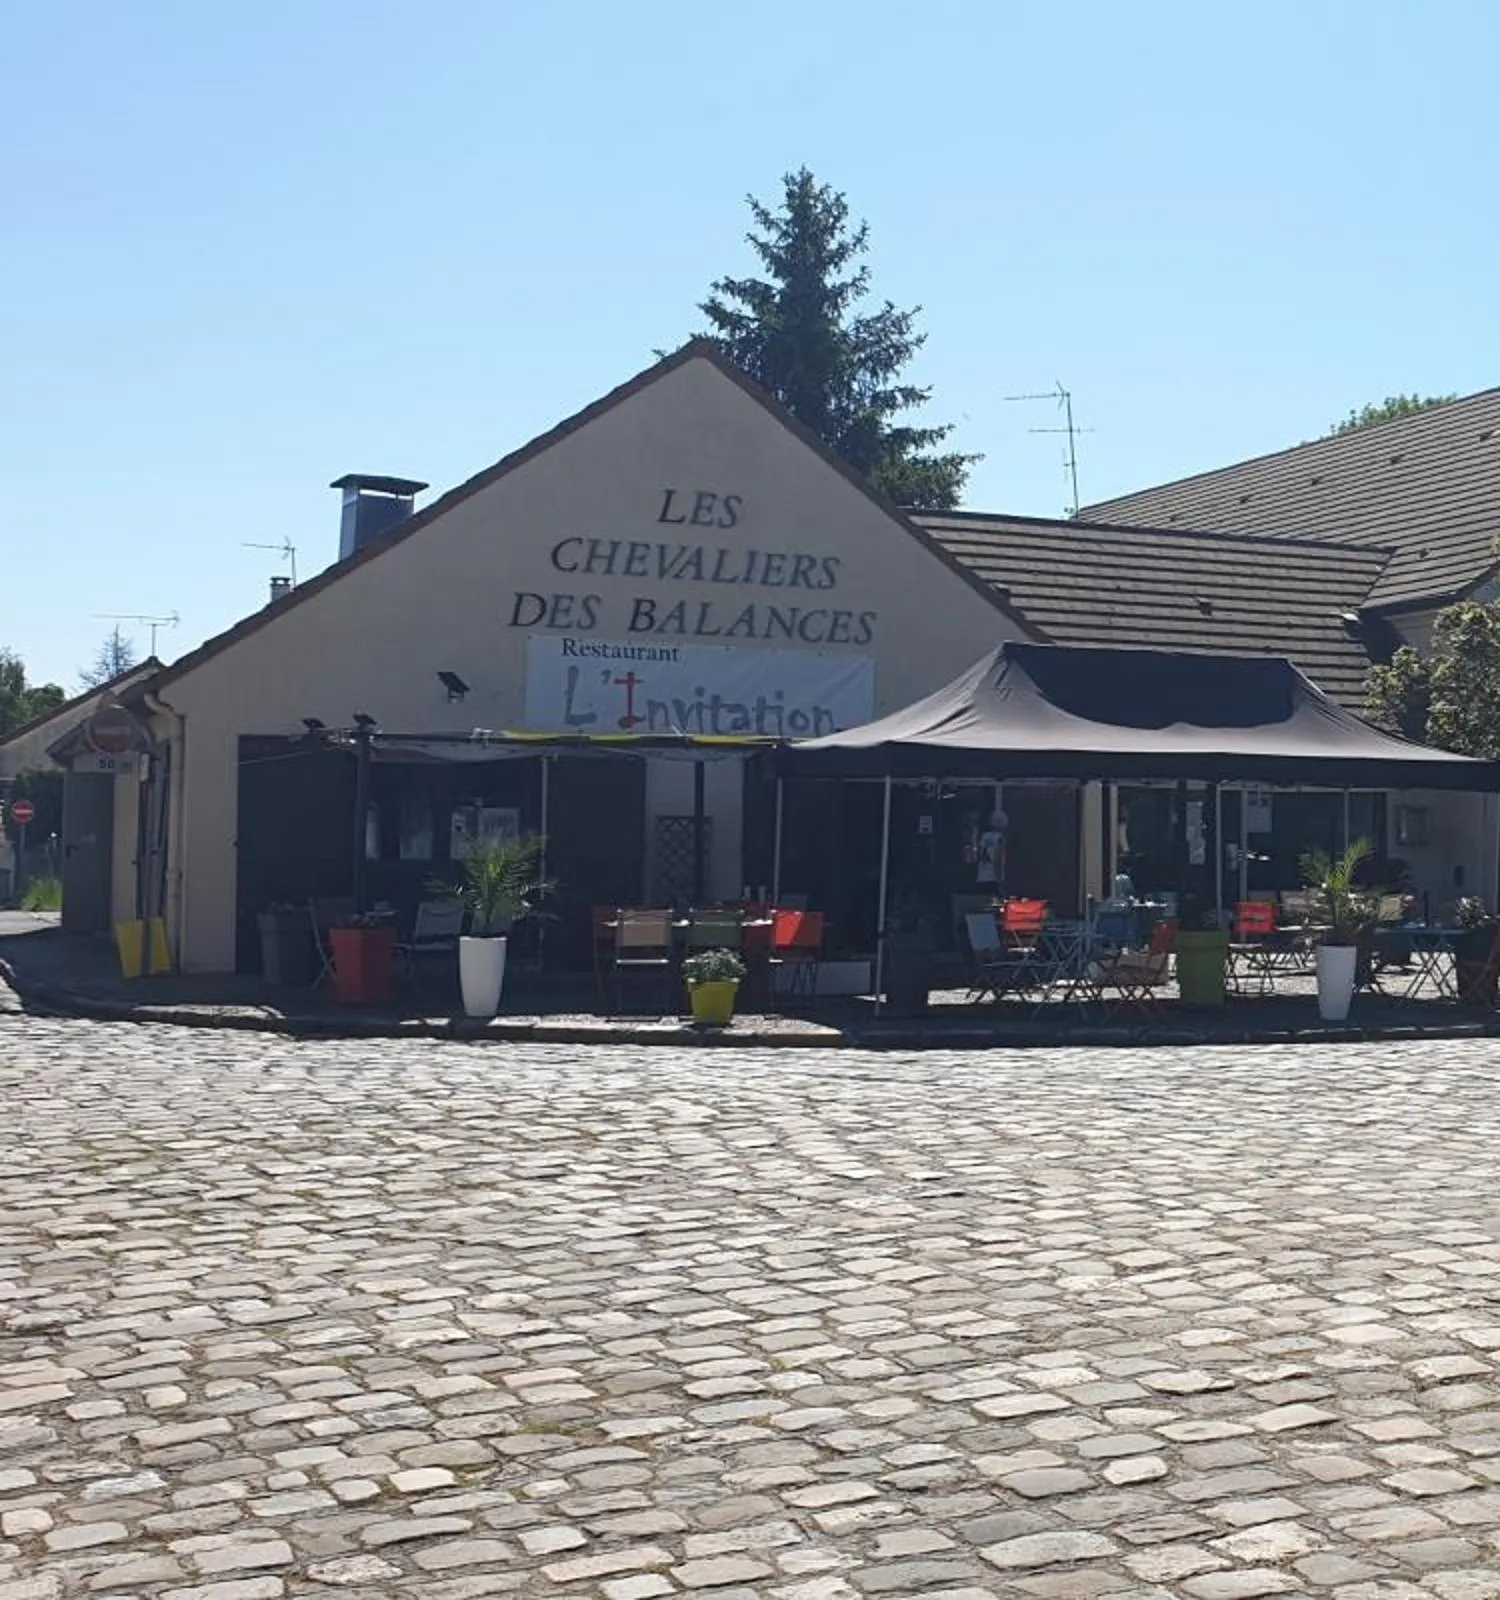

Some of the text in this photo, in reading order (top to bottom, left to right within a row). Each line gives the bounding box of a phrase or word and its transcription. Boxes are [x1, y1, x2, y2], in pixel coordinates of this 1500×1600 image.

[657, 488, 743, 528] LES
[550, 537, 841, 591] CHEVALIERS
[508, 591, 878, 646] DES BALANCES
[562, 637, 680, 663] Restaurant
